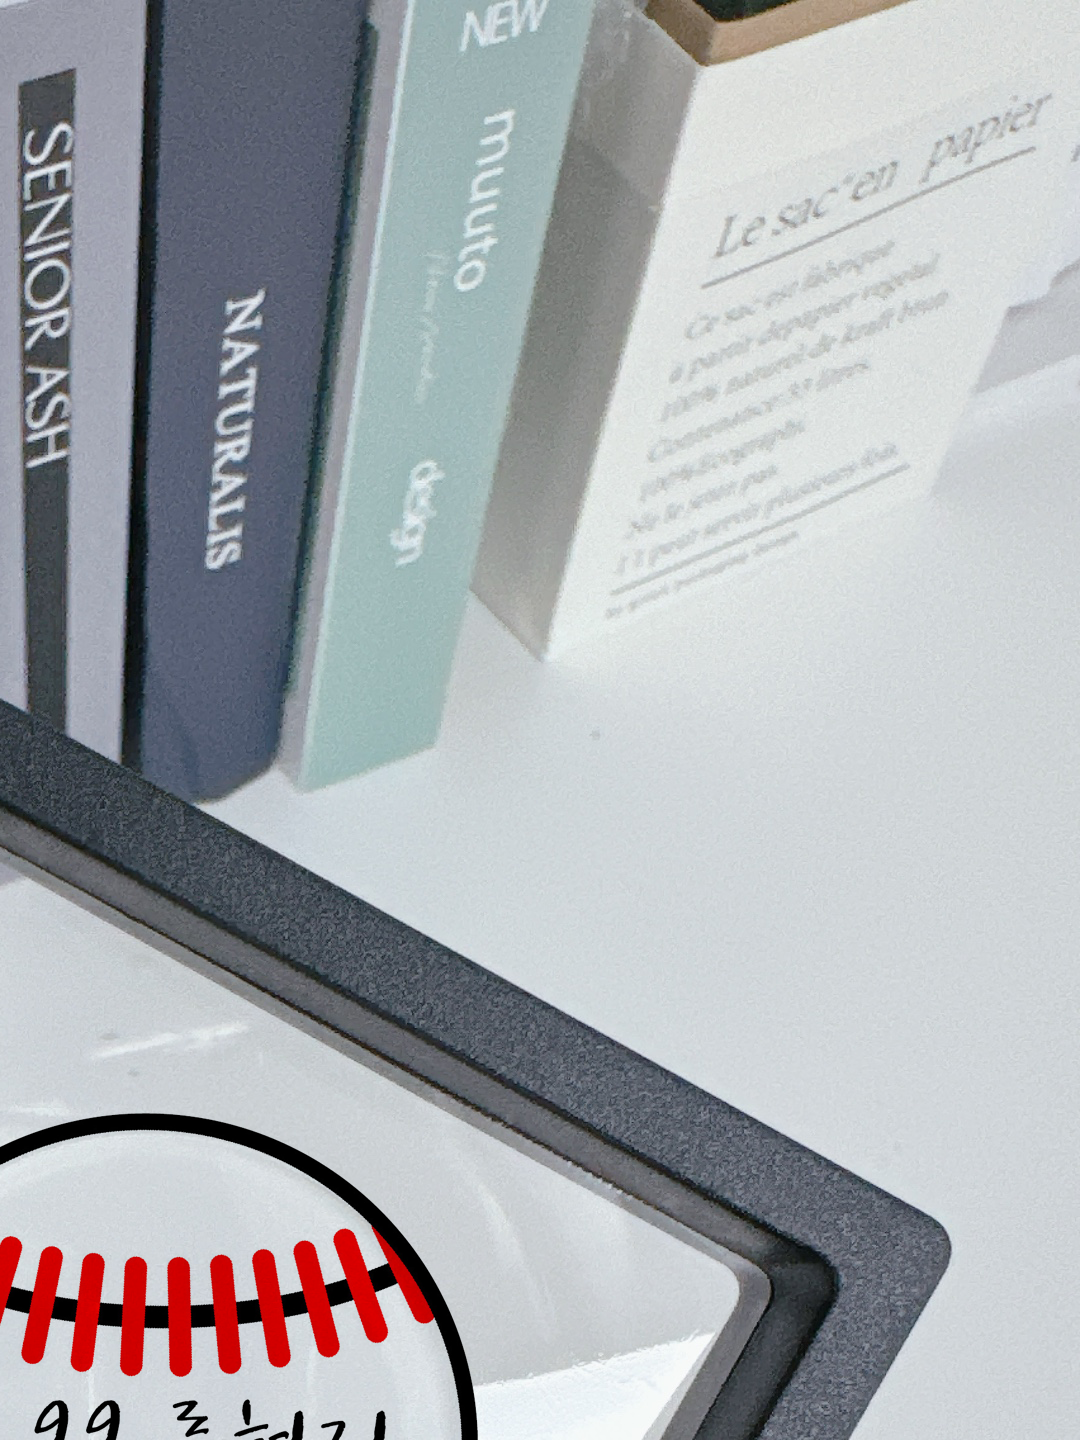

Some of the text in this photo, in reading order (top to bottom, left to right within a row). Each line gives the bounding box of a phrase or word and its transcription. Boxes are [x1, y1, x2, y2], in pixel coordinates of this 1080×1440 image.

[460, 0, 550, 52] NEW
[453, 108, 516, 292] muuto
[919, 92, 1052, 184] papier
[23, 121, 74, 469] SENIOR ASH
[205, 288, 266, 571] NATURALIS
